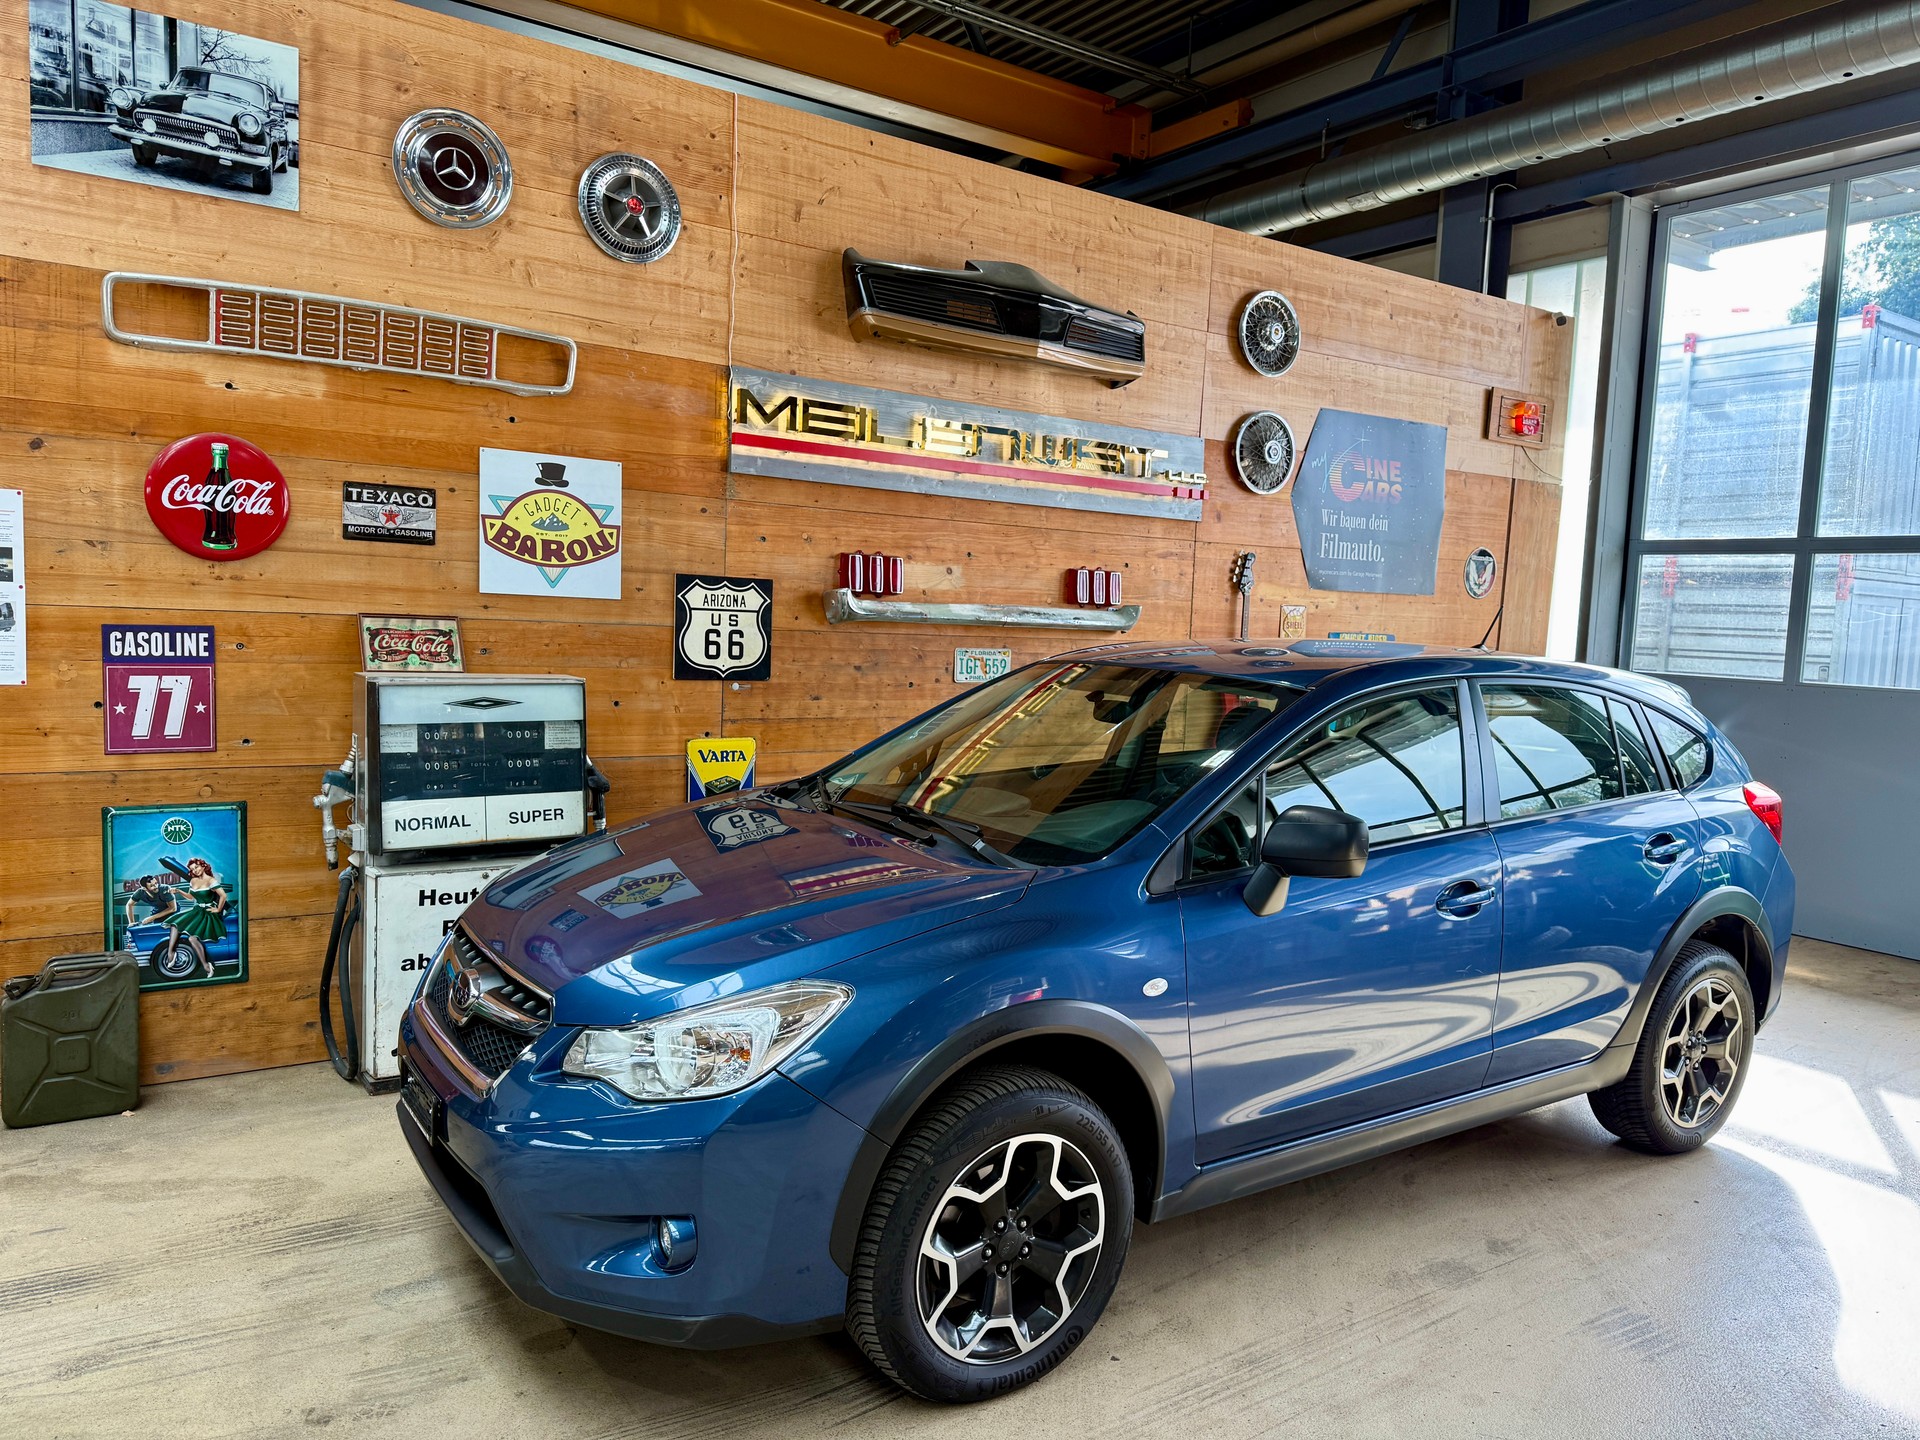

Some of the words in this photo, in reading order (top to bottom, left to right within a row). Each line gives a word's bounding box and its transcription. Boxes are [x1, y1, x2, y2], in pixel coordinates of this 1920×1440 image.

[161, 474, 277, 515] Coca-Cola
[347, 487, 434, 507] TEXACO
[523, 496, 581, 520] GADGET
[1321, 508, 1338, 527] Wir
[1340, 510, 1366, 530] bauen
[1369, 513, 1390, 531] dein
[347, 525, 376, 534] MOTOR
[394, 529, 433, 538] GASOLINE
[490, 522, 615, 563] BARON
[1320, 532, 1385, 562] Filmauto.
[702, 593, 746, 608] ARIZONA
[1286, 620, 1303, 631] SHELL
[109, 631, 209, 657] GASOLINE
[374, 633, 450, 653] Coca-Cola
[704, 628, 744, 660] 66
[127, 675, 193, 739] 77
[697, 749, 748, 763] VARTA
[395, 814, 472, 832] NORMAL
[508, 807, 564, 825] SUPER
[167, 824, 187, 832] NTK
[1076, 1113, 1109, 1147] 225/55
[889, 1172, 942, 1318] AllSeasonContact
[989, 1325, 1085, 1396] Continental
